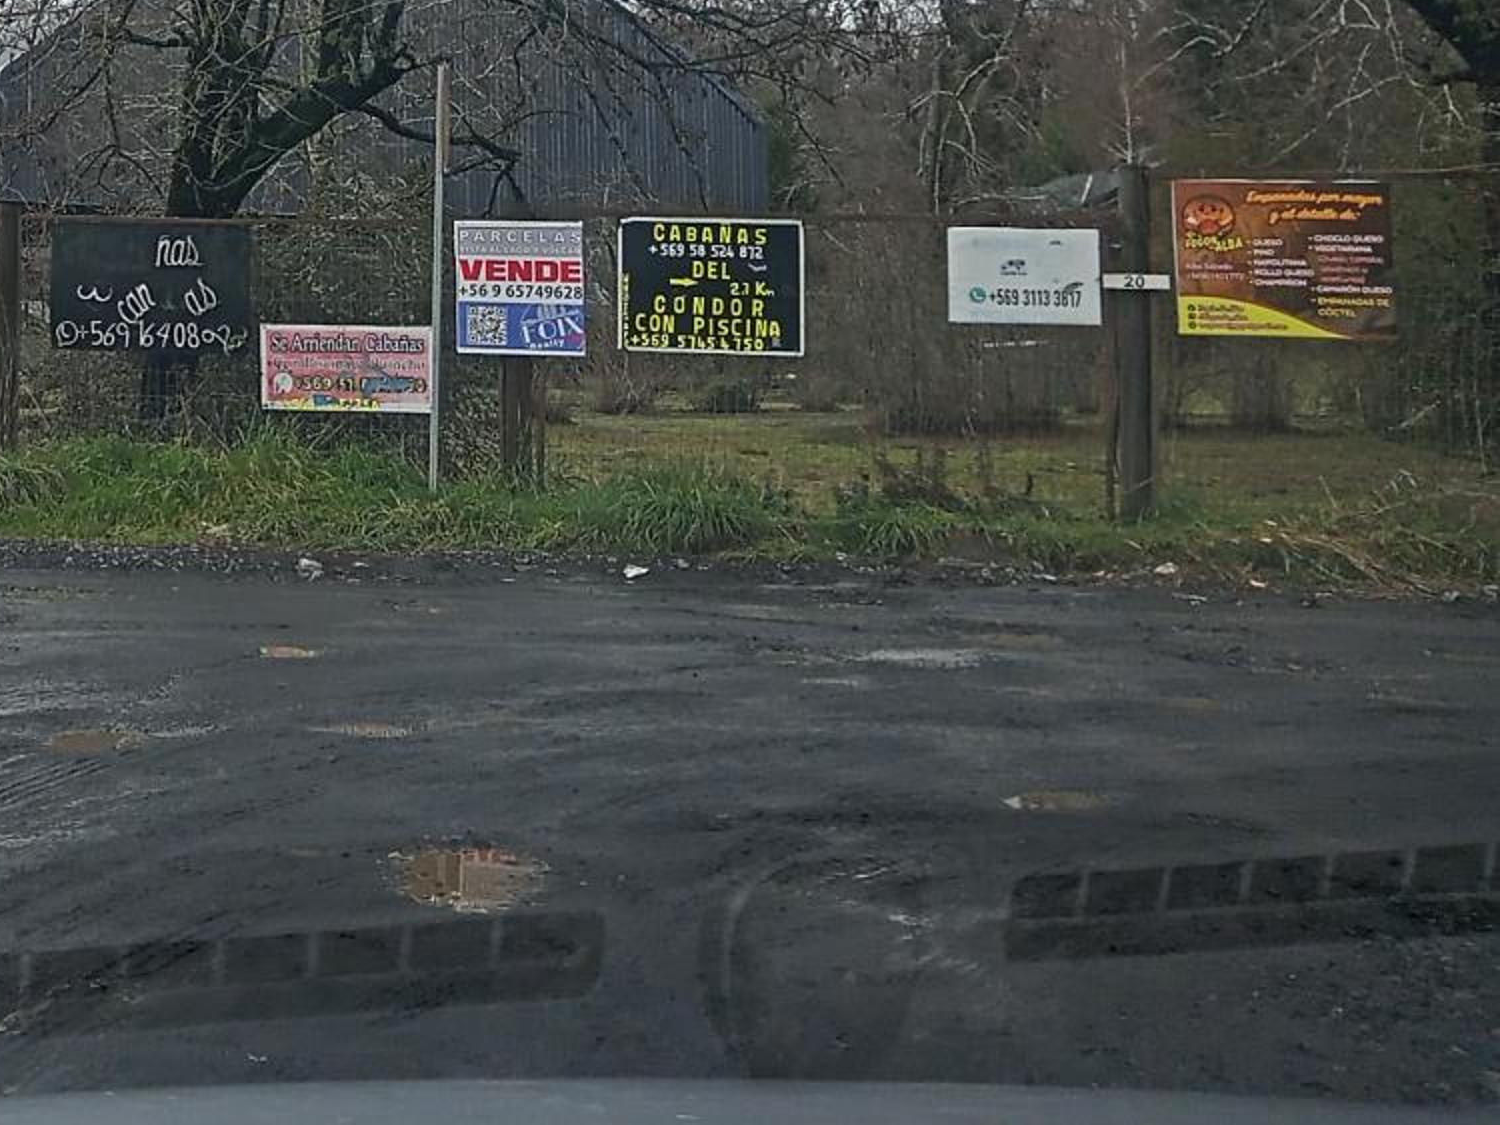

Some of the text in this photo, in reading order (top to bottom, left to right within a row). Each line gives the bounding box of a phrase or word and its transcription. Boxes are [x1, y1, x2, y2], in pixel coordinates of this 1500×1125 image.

[459, 230, 581, 242] PARCELAS
[649, 243, 685, 257] +569
[459, 259, 582, 283] VENDE
[692, 261, 731, 280] DEL
[1123, 276, 1145, 288] 20
[459, 283, 583, 300] +56 9 65749628
[989, 288, 1019, 306] +569
[1022, 289, 1051, 307] 3113
[635, 313, 781, 338] CON PISCINA
[271, 333, 288, 352] Se
[365, 333, 425, 353] Cabañas
[631, 334, 669, 347] +569
